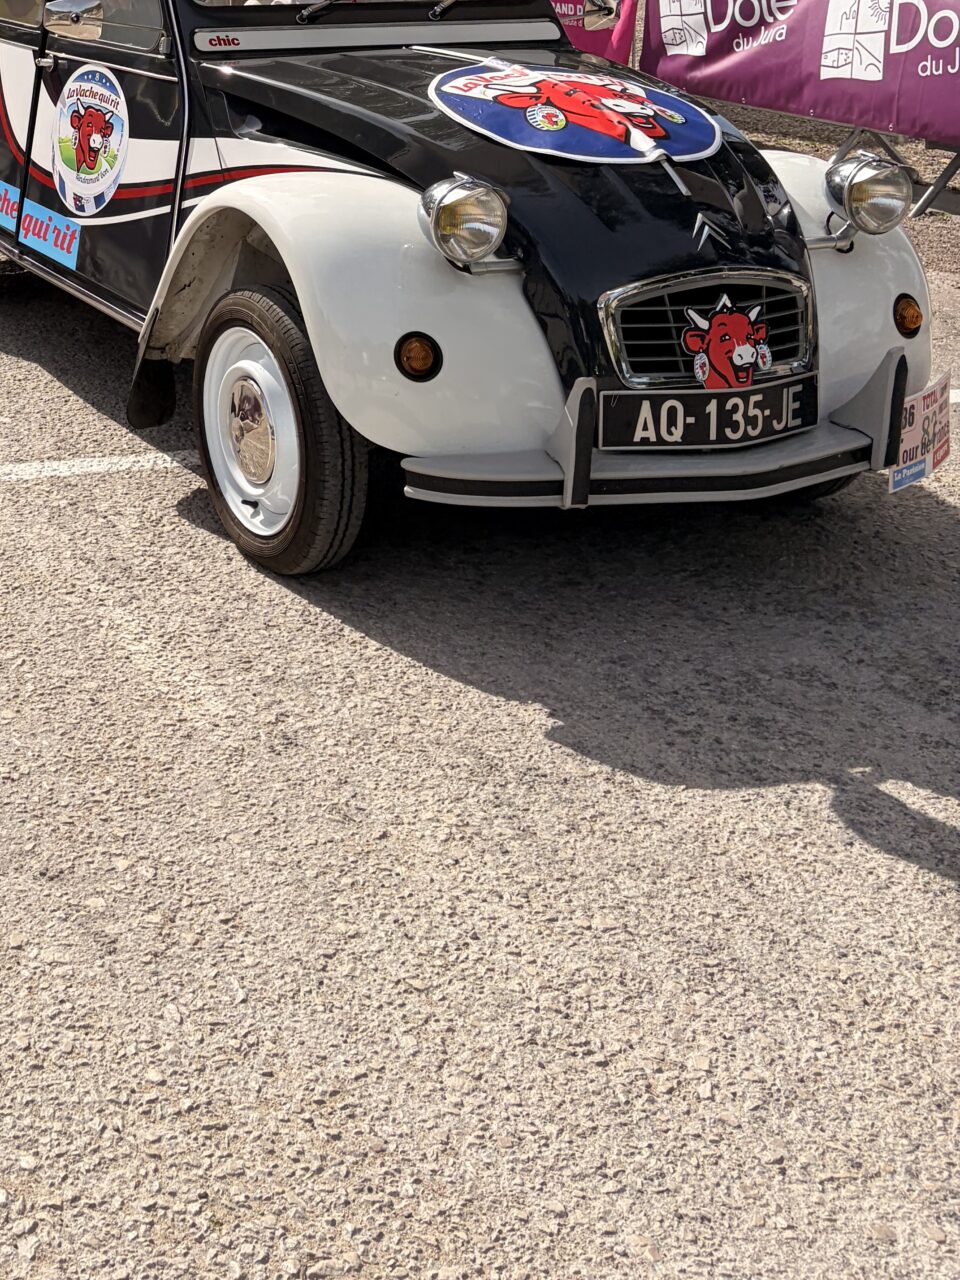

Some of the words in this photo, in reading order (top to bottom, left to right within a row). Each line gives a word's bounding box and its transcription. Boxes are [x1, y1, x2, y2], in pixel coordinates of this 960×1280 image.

[208, 35, 241, 47] chic
[732, 32, 753, 53] du
[753, 24, 787, 50] Jura
[917, 55, 943, 77] du
[66, 86, 75, 99] La
[75, 84, 98, 100] Vache
[98, 92, 111, 106] qui
[110, 97, 119, 111] rit
[21, 212, 53, 244] qui
[53, 223, 78, 255] rit
[633, 384, 804, 443] AQ-135-JE
